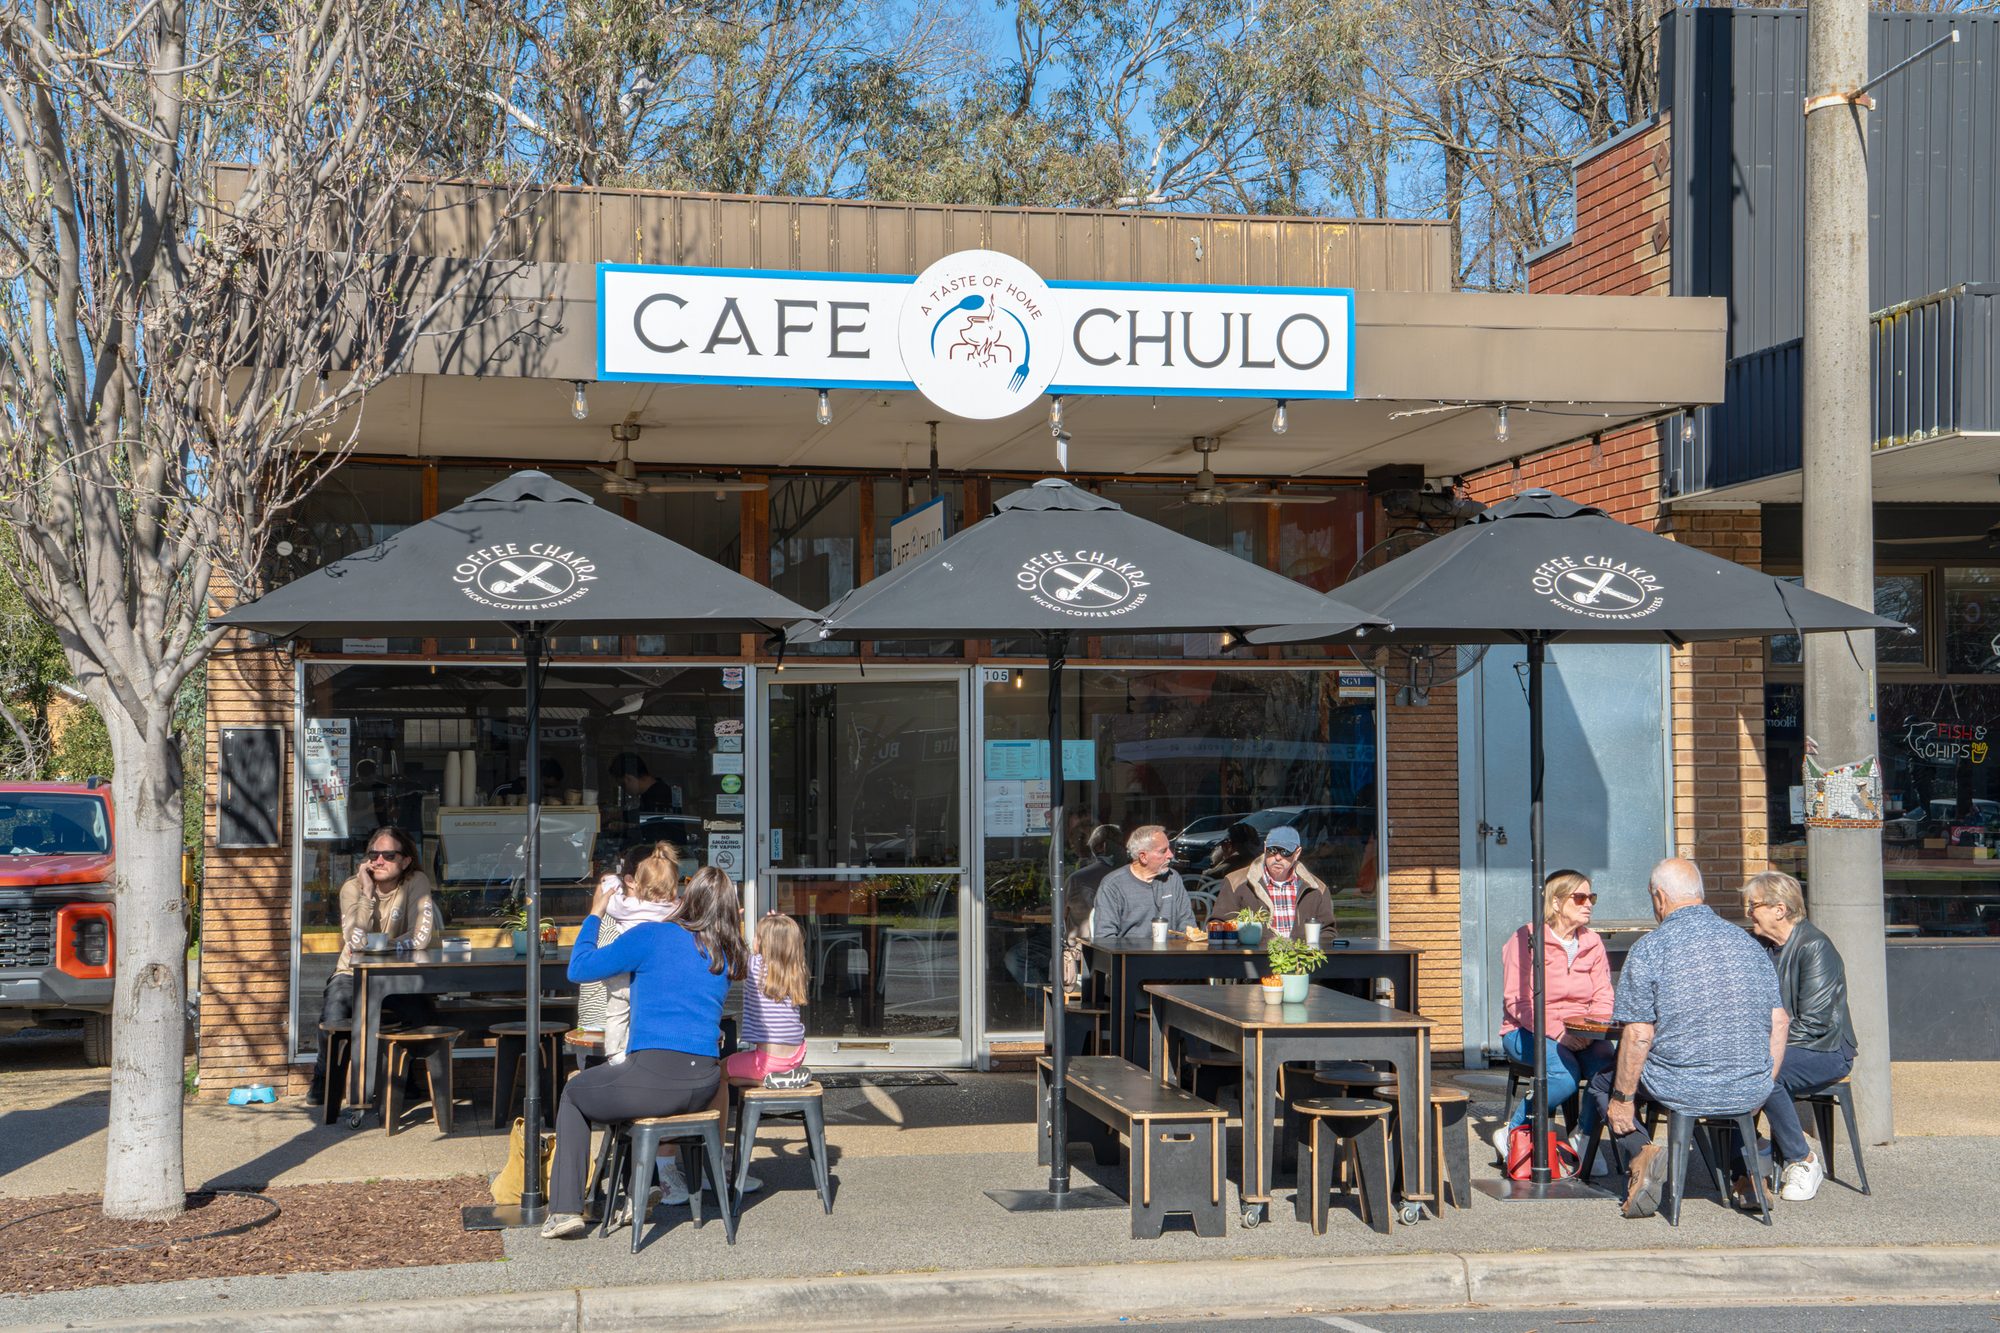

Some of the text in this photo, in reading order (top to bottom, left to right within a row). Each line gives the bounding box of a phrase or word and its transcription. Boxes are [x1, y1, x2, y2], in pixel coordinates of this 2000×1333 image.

[921, 275, 1043, 320] A TASTE OF HOME
[633, 292, 1330, 369] CAFE CHULO
[452, 543, 599, 583] COFFEE CHAKRA
[1017, 550, 1151, 591] COFFEE CHAKRA
[1532, 555, 1665, 595] COFFEE CHAKRA
[461, 586, 590, 611] MICRO-COFFEE ROASTERS
[1030, 593, 1148, 618] MICRO-COFFEE ROASTERS
[1550, 596, 1664, 620] MICRO-COFFEE ROASTERS
[984, 670, 1008, 682] 105
[1341, 677, 1361, 686] SGM
[1937, 722, 1988, 741] FISH &
[1924, 742, 1970, 759] CHIPS
